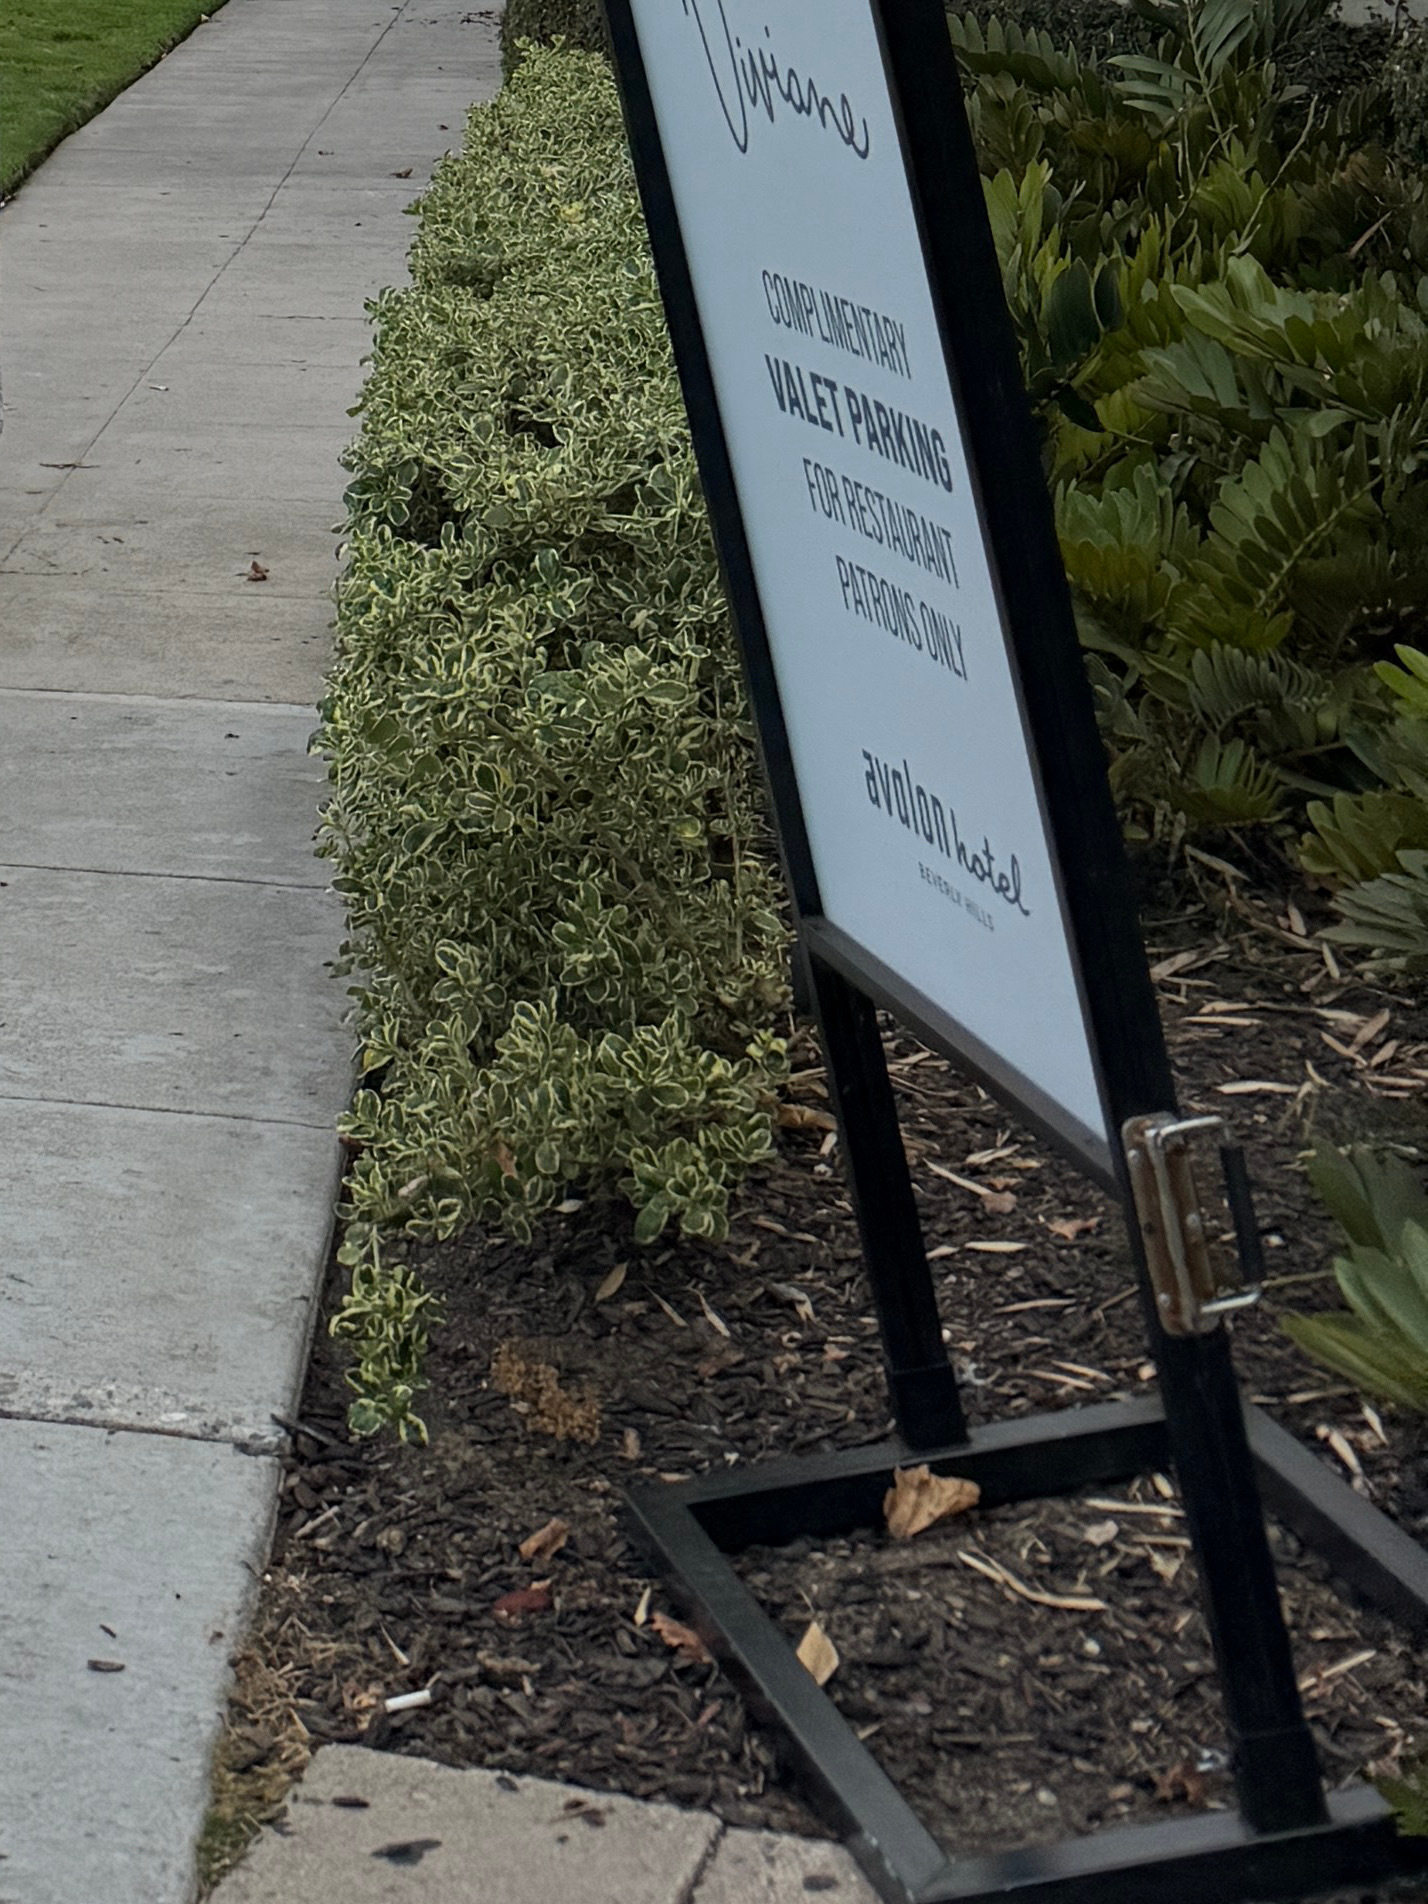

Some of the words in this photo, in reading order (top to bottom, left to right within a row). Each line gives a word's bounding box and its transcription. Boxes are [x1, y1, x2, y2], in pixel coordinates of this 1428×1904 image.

[762, 269, 912, 380] COMPLIMENTARY
[764, 353, 844, 438] VALET
[844, 385, 953, 494] PARKING
[802, 457, 846, 526] FOR
[841, 474, 960, 590] RESTAURANT
[835, 554, 922, 652] PATRONS
[920, 600, 968, 682] ONLY
[861, 748, 951, 859] avalon
[950, 807, 1030, 917] hotel
